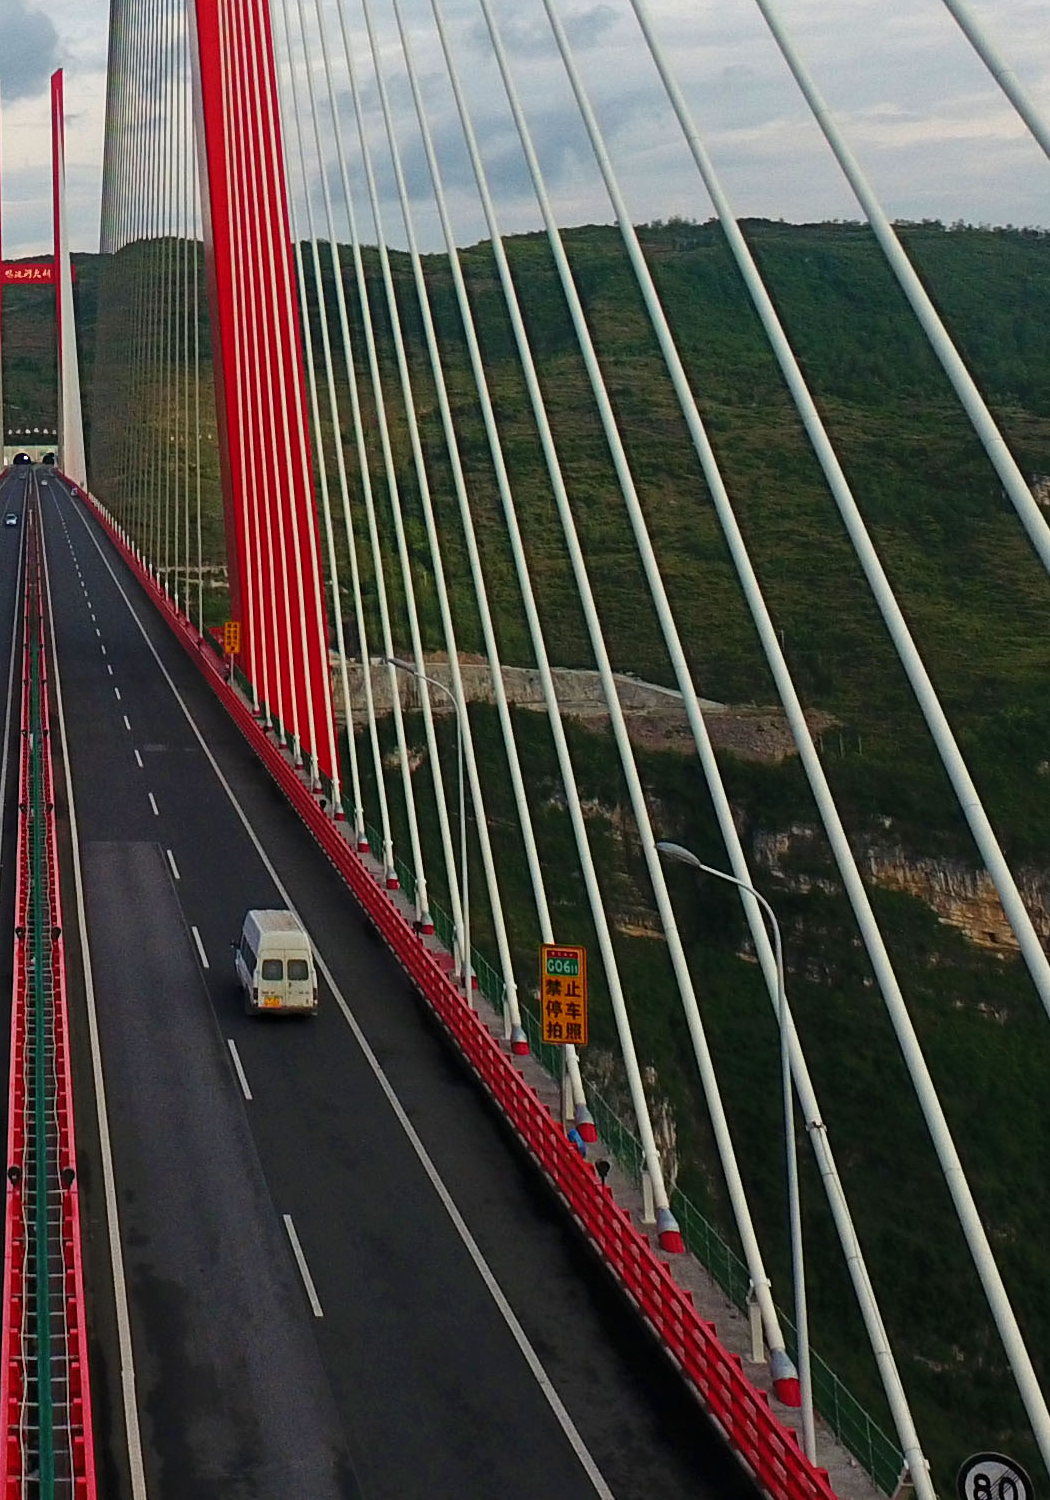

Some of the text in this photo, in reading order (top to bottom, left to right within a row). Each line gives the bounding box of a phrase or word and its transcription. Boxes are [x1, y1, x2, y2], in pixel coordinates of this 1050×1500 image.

[545, 979, 582, 998] 禁止
[545, 1000, 582, 1020] 停车
[546, 1021, 582, 1040] 拍照
[973, 1473, 1019, 1500] 80
